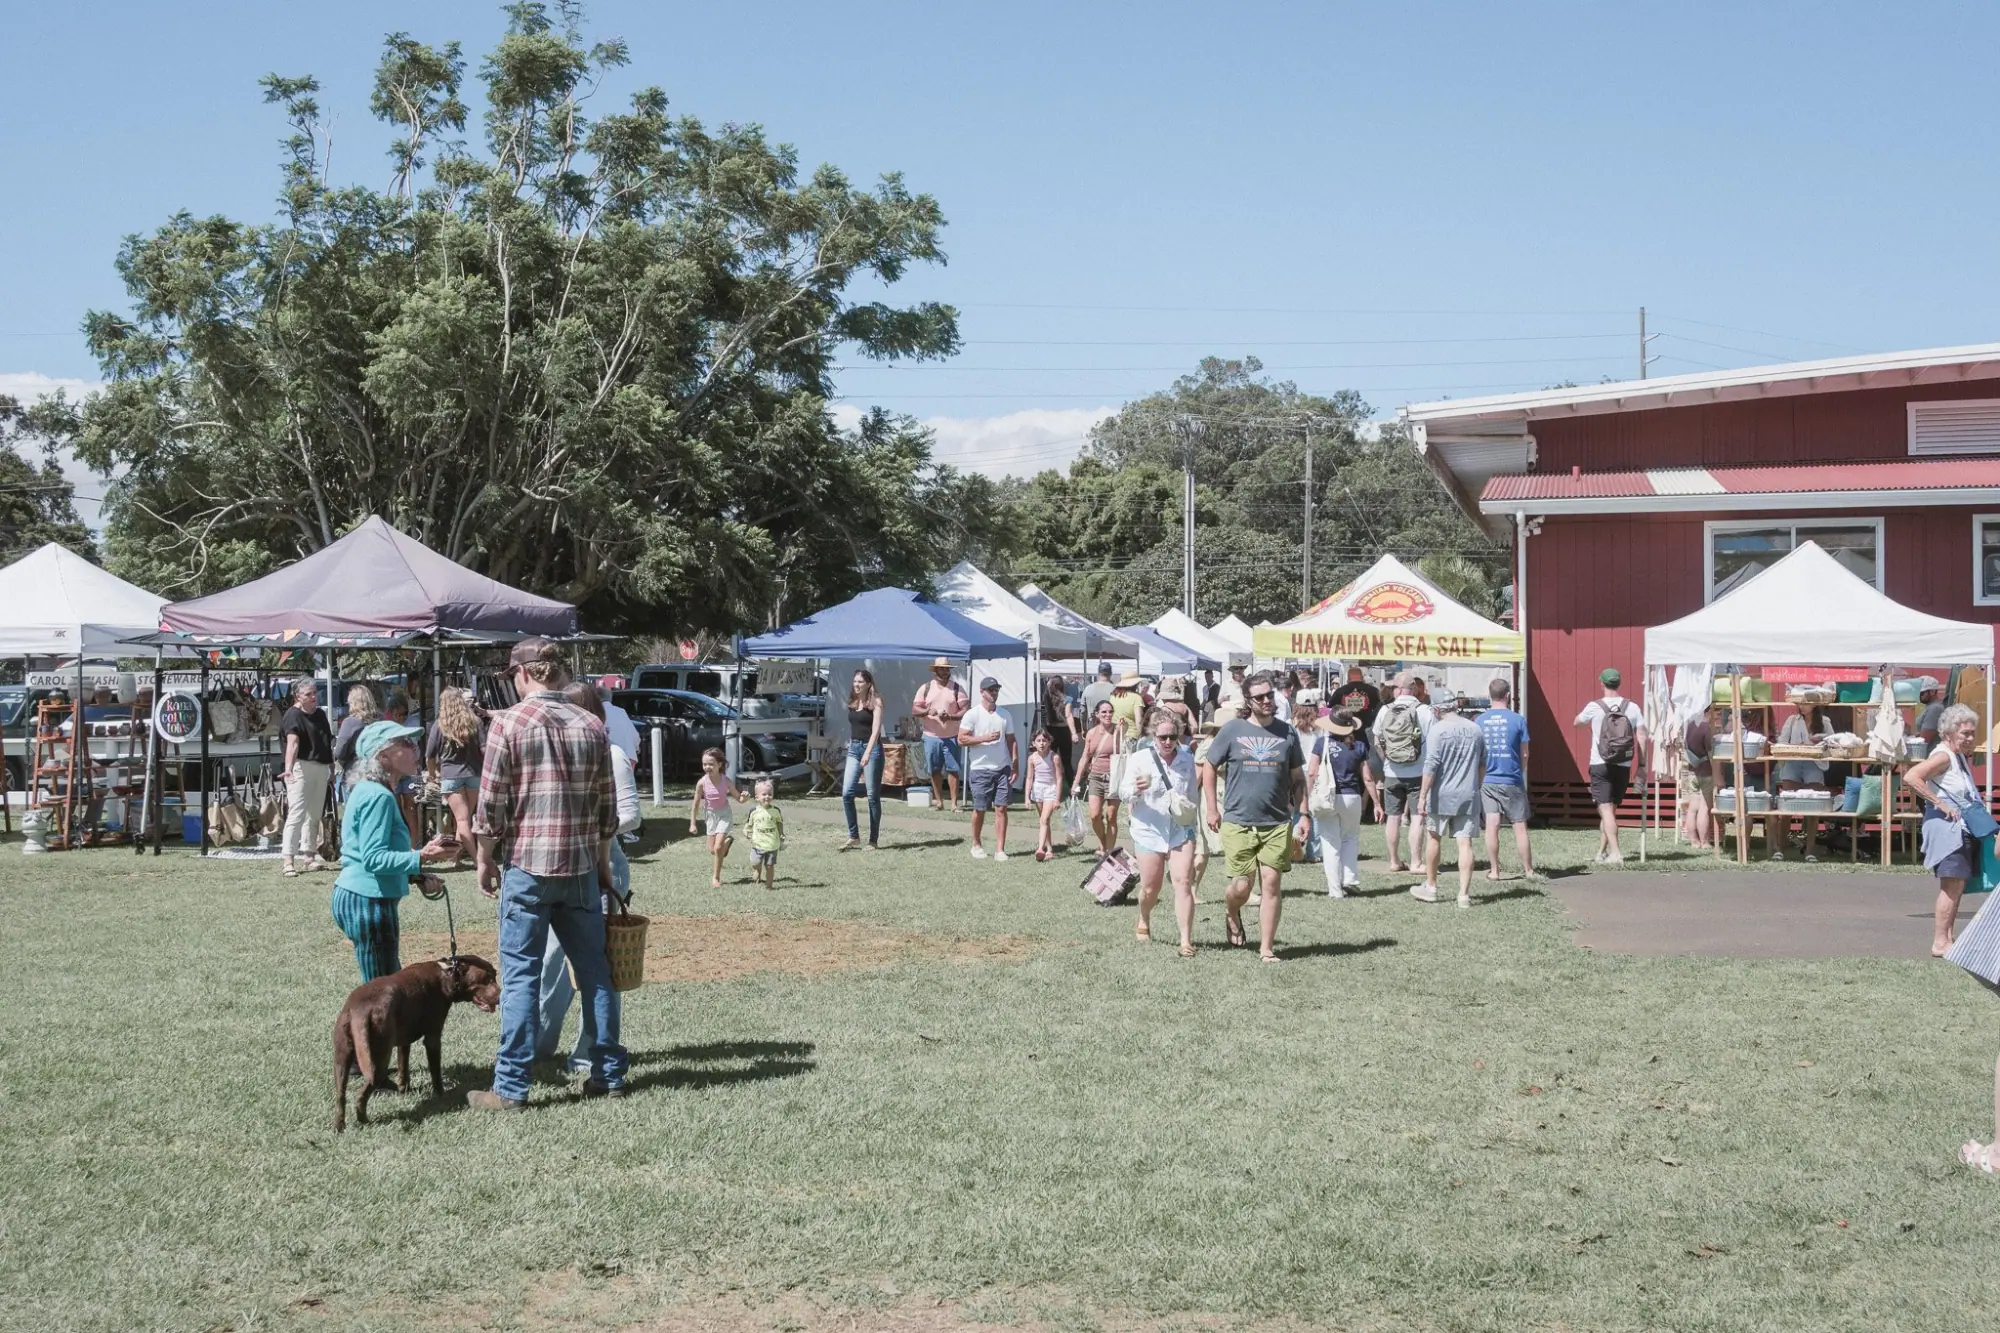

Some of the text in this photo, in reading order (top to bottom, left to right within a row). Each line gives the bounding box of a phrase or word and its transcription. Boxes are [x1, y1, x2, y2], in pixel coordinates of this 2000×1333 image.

[1361, 612, 1417, 623] SEA SALT
[1291, 633, 1485, 658] HAWAIIAN SEA SALT
[29, 675, 67, 686] CAROL
[166, 699, 192, 711] kona
